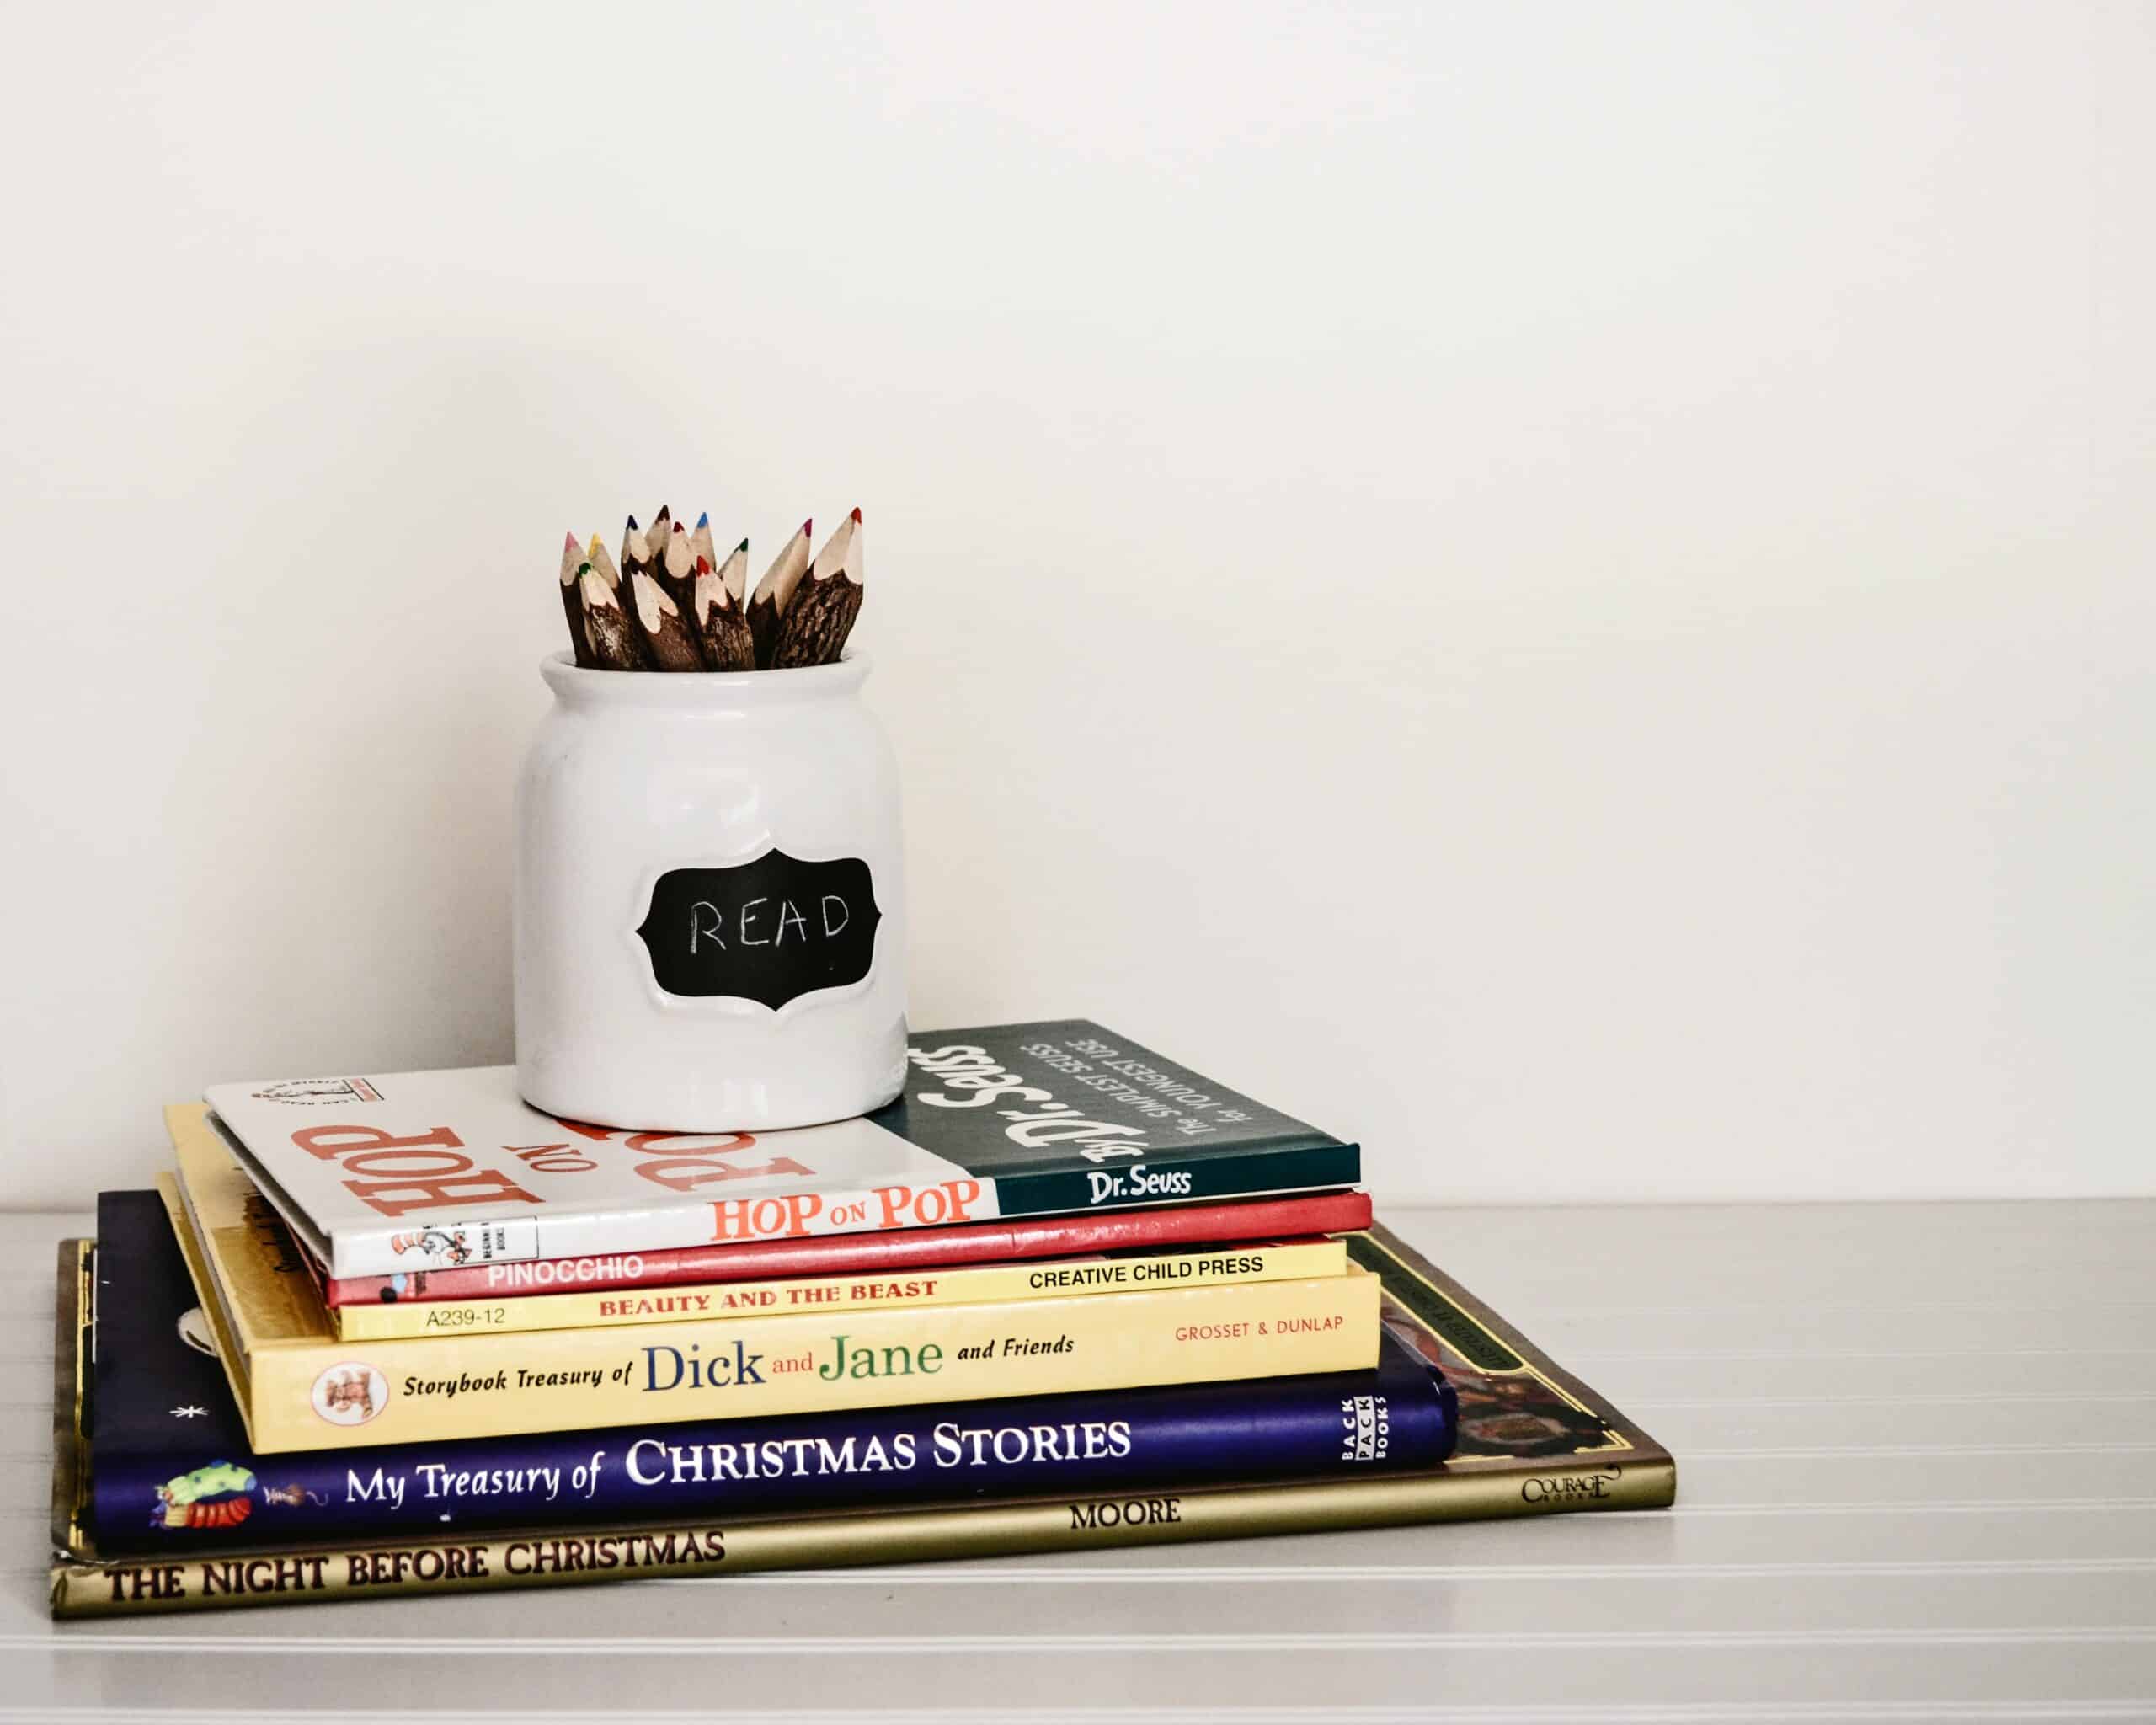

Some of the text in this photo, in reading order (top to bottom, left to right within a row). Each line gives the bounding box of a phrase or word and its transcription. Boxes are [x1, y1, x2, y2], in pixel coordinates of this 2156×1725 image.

[690, 895, 850, 955] READ
[907, 1044, 1054, 1108] Seuss
[1065, 1039, 1118, 1060] USE
[1020, 1043, 1218, 1136] The SIMPLEST SEUSS
[1102, 1059, 1221, 1111] YOUNGEST
[996, 1102, 1147, 1148] Dr.
[291, 1124, 546, 1217] HOP
[500, 1143, 599, 1174] ON
[1086, 1164, 1192, 1204] Dr. Seuss
[707, 1178, 981, 1242] HOP ON POP
[487, 1255, 644, 1288] PINOCCHIO
[599, 1280, 939, 1318] BEAUTY AND THE BEAST
[1030, 1256, 1264, 1289] CREATIVE CHILD PRESS
[426, 1306, 506, 1327] A239-12
[1175, 1316, 1343, 1342] GROSSET & DUNLAP
[403, 1334, 1075, 1398] Storybook Treasury of Dick and Jane and Friends
[1341, 1399, 1356, 1461] BACK
[1359, 1399, 1372, 1458] PACK
[1374, 1396, 1389, 1458] BOOKS
[345, 1422, 1131, 1510] My Treasury of CHRISTMAS STORIES
[1070, 1498, 1182, 1530] MOORE
[104, 1530, 726, 1601] THE NIGHT BEFORE CHRISTMAS
